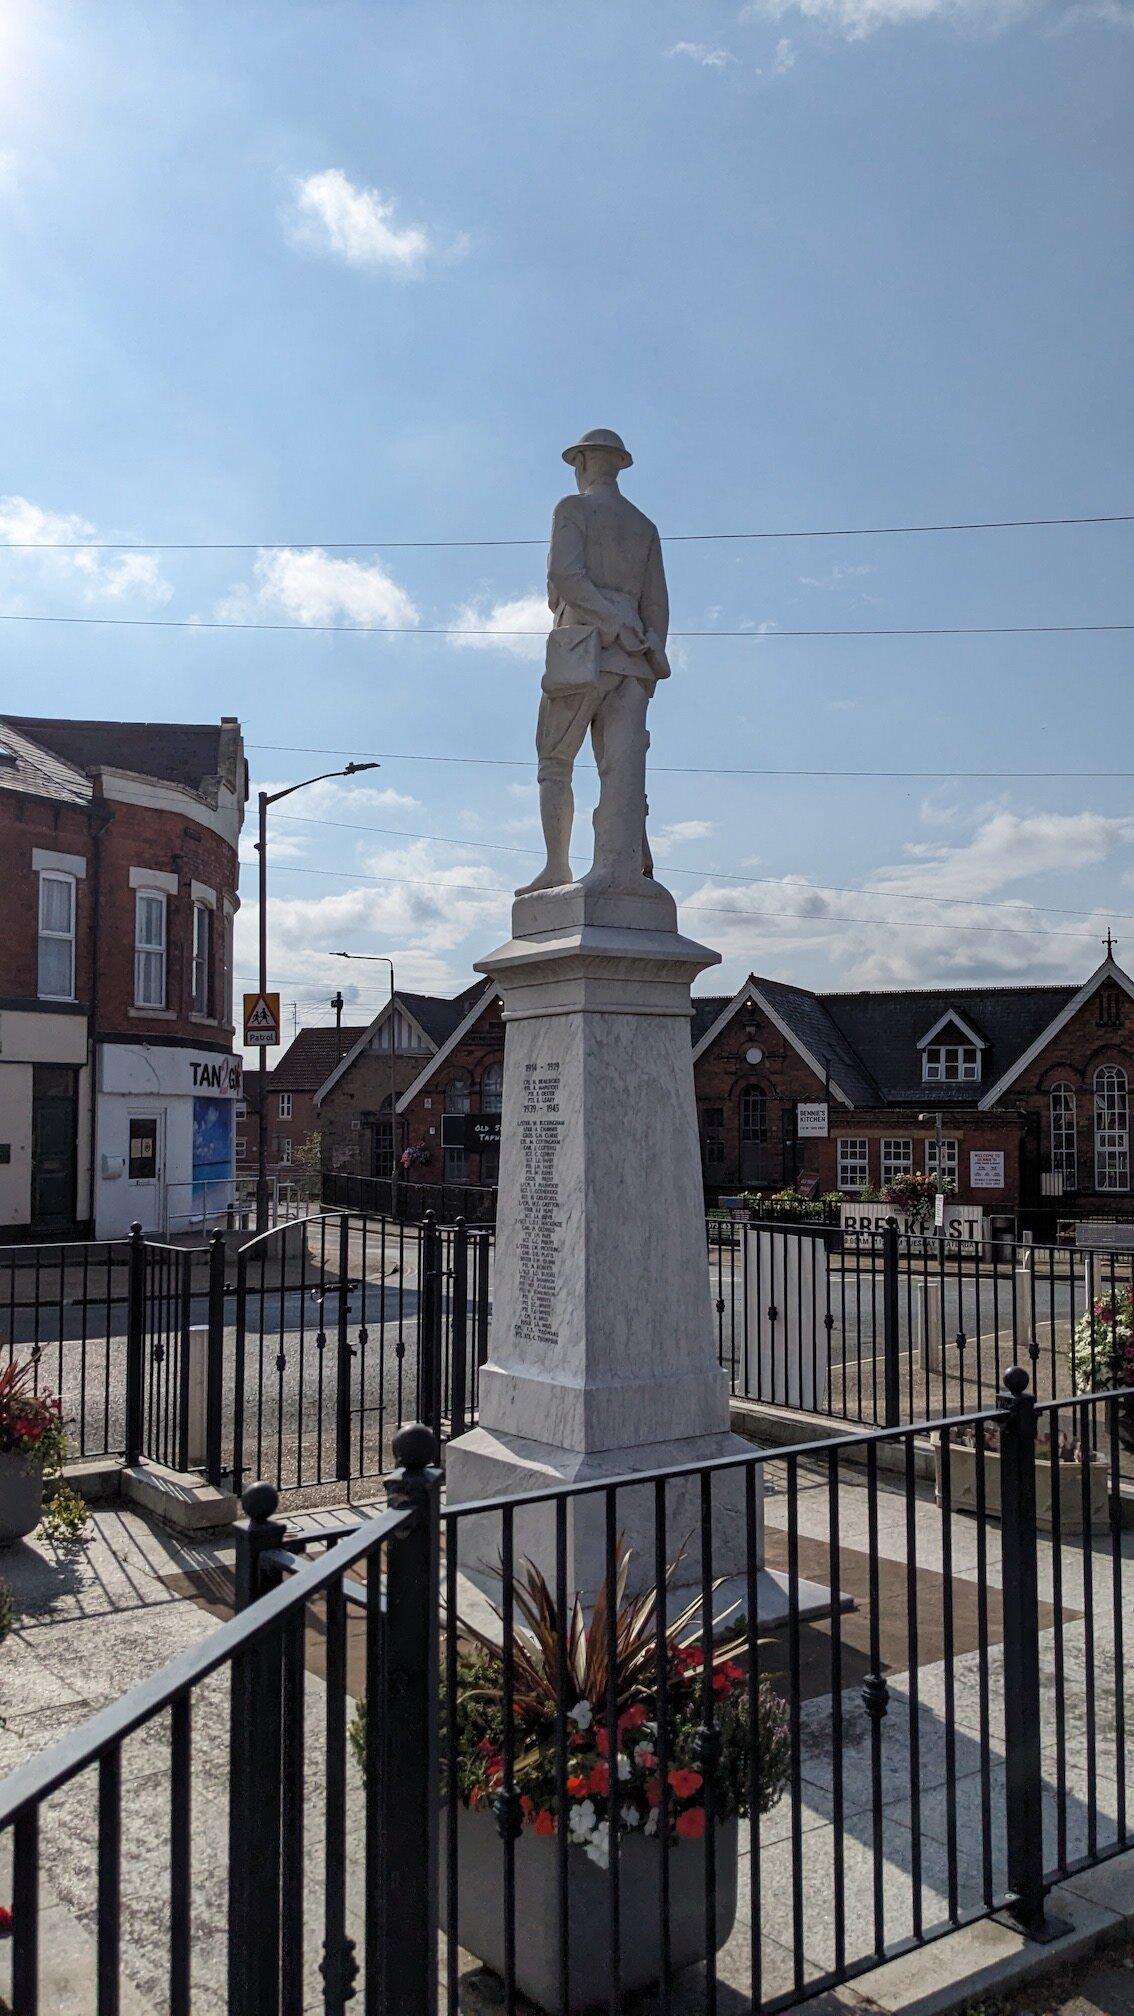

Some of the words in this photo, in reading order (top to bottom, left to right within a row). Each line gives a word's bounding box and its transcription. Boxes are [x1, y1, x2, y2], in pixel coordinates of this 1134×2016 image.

[250, 1033, 273, 1042] Patrol
[525, 1063, 538, 1072] 1914
[524, 1104, 537, 1113] 1939
[547, 1104, 560, 1113] 1945
